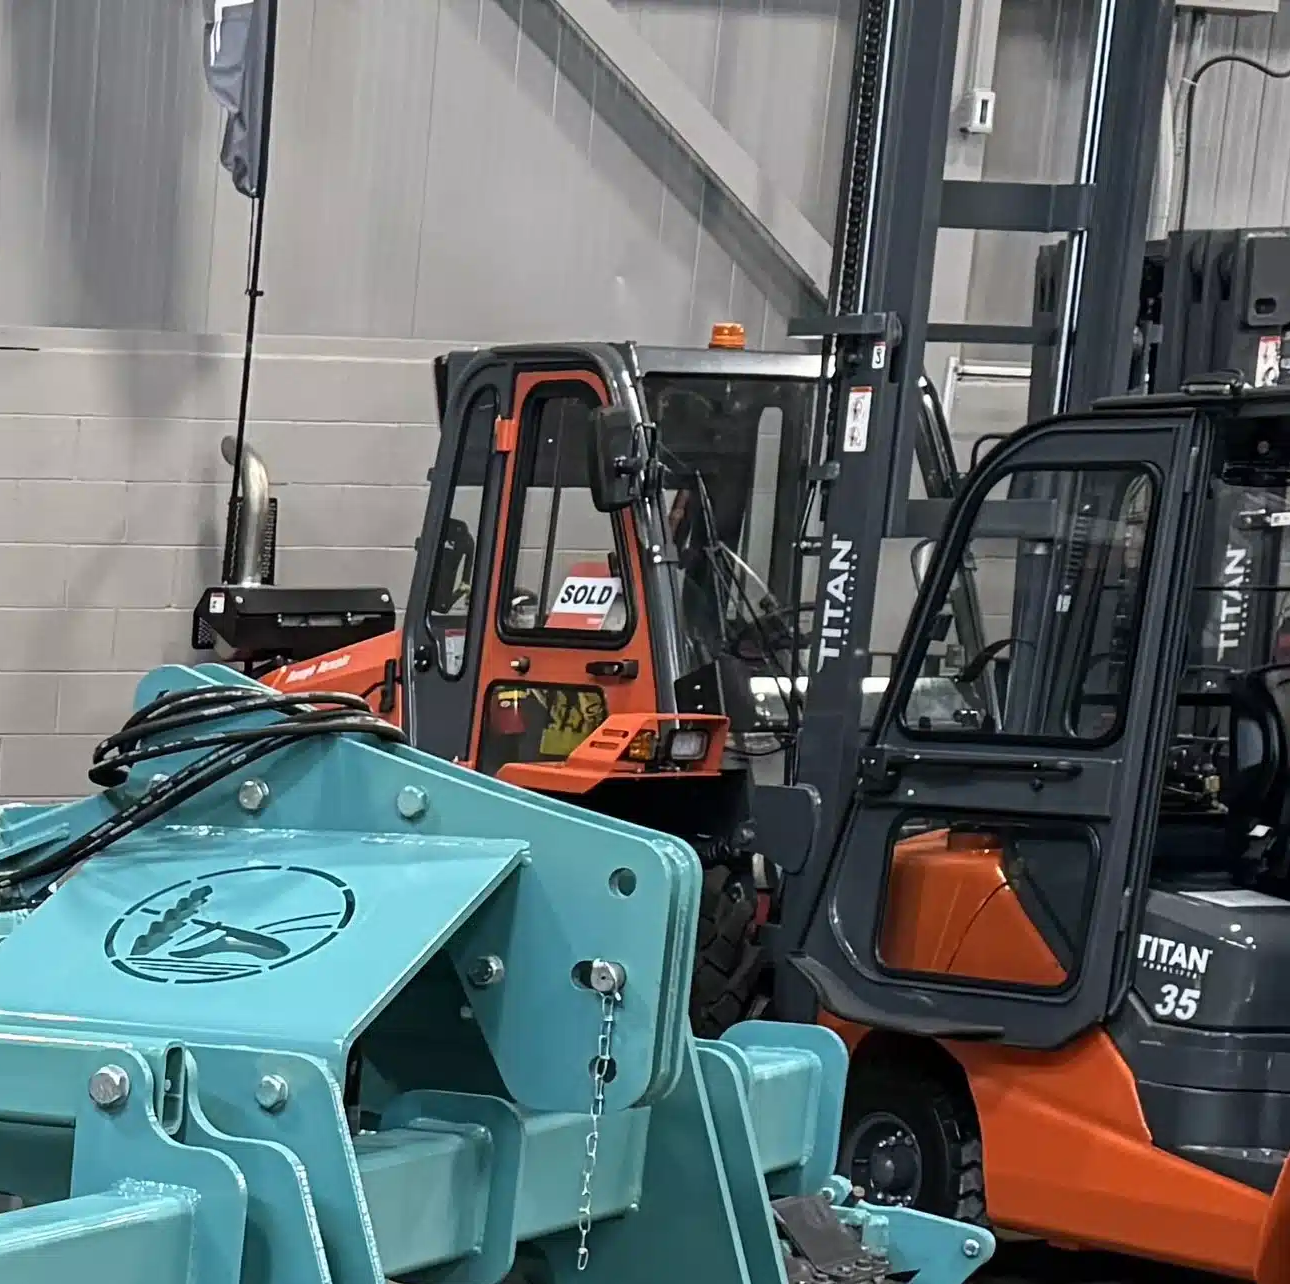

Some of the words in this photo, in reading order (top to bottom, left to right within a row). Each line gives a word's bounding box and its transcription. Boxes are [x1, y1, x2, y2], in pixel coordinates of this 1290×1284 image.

[560, 584, 613, 605] SOLD
[816, 537, 854, 673] TITAN
[1217, 546, 1247, 662] TITAN
[1137, 934, 1211, 973] TITAN
[1154, 983, 1201, 1021] 35
